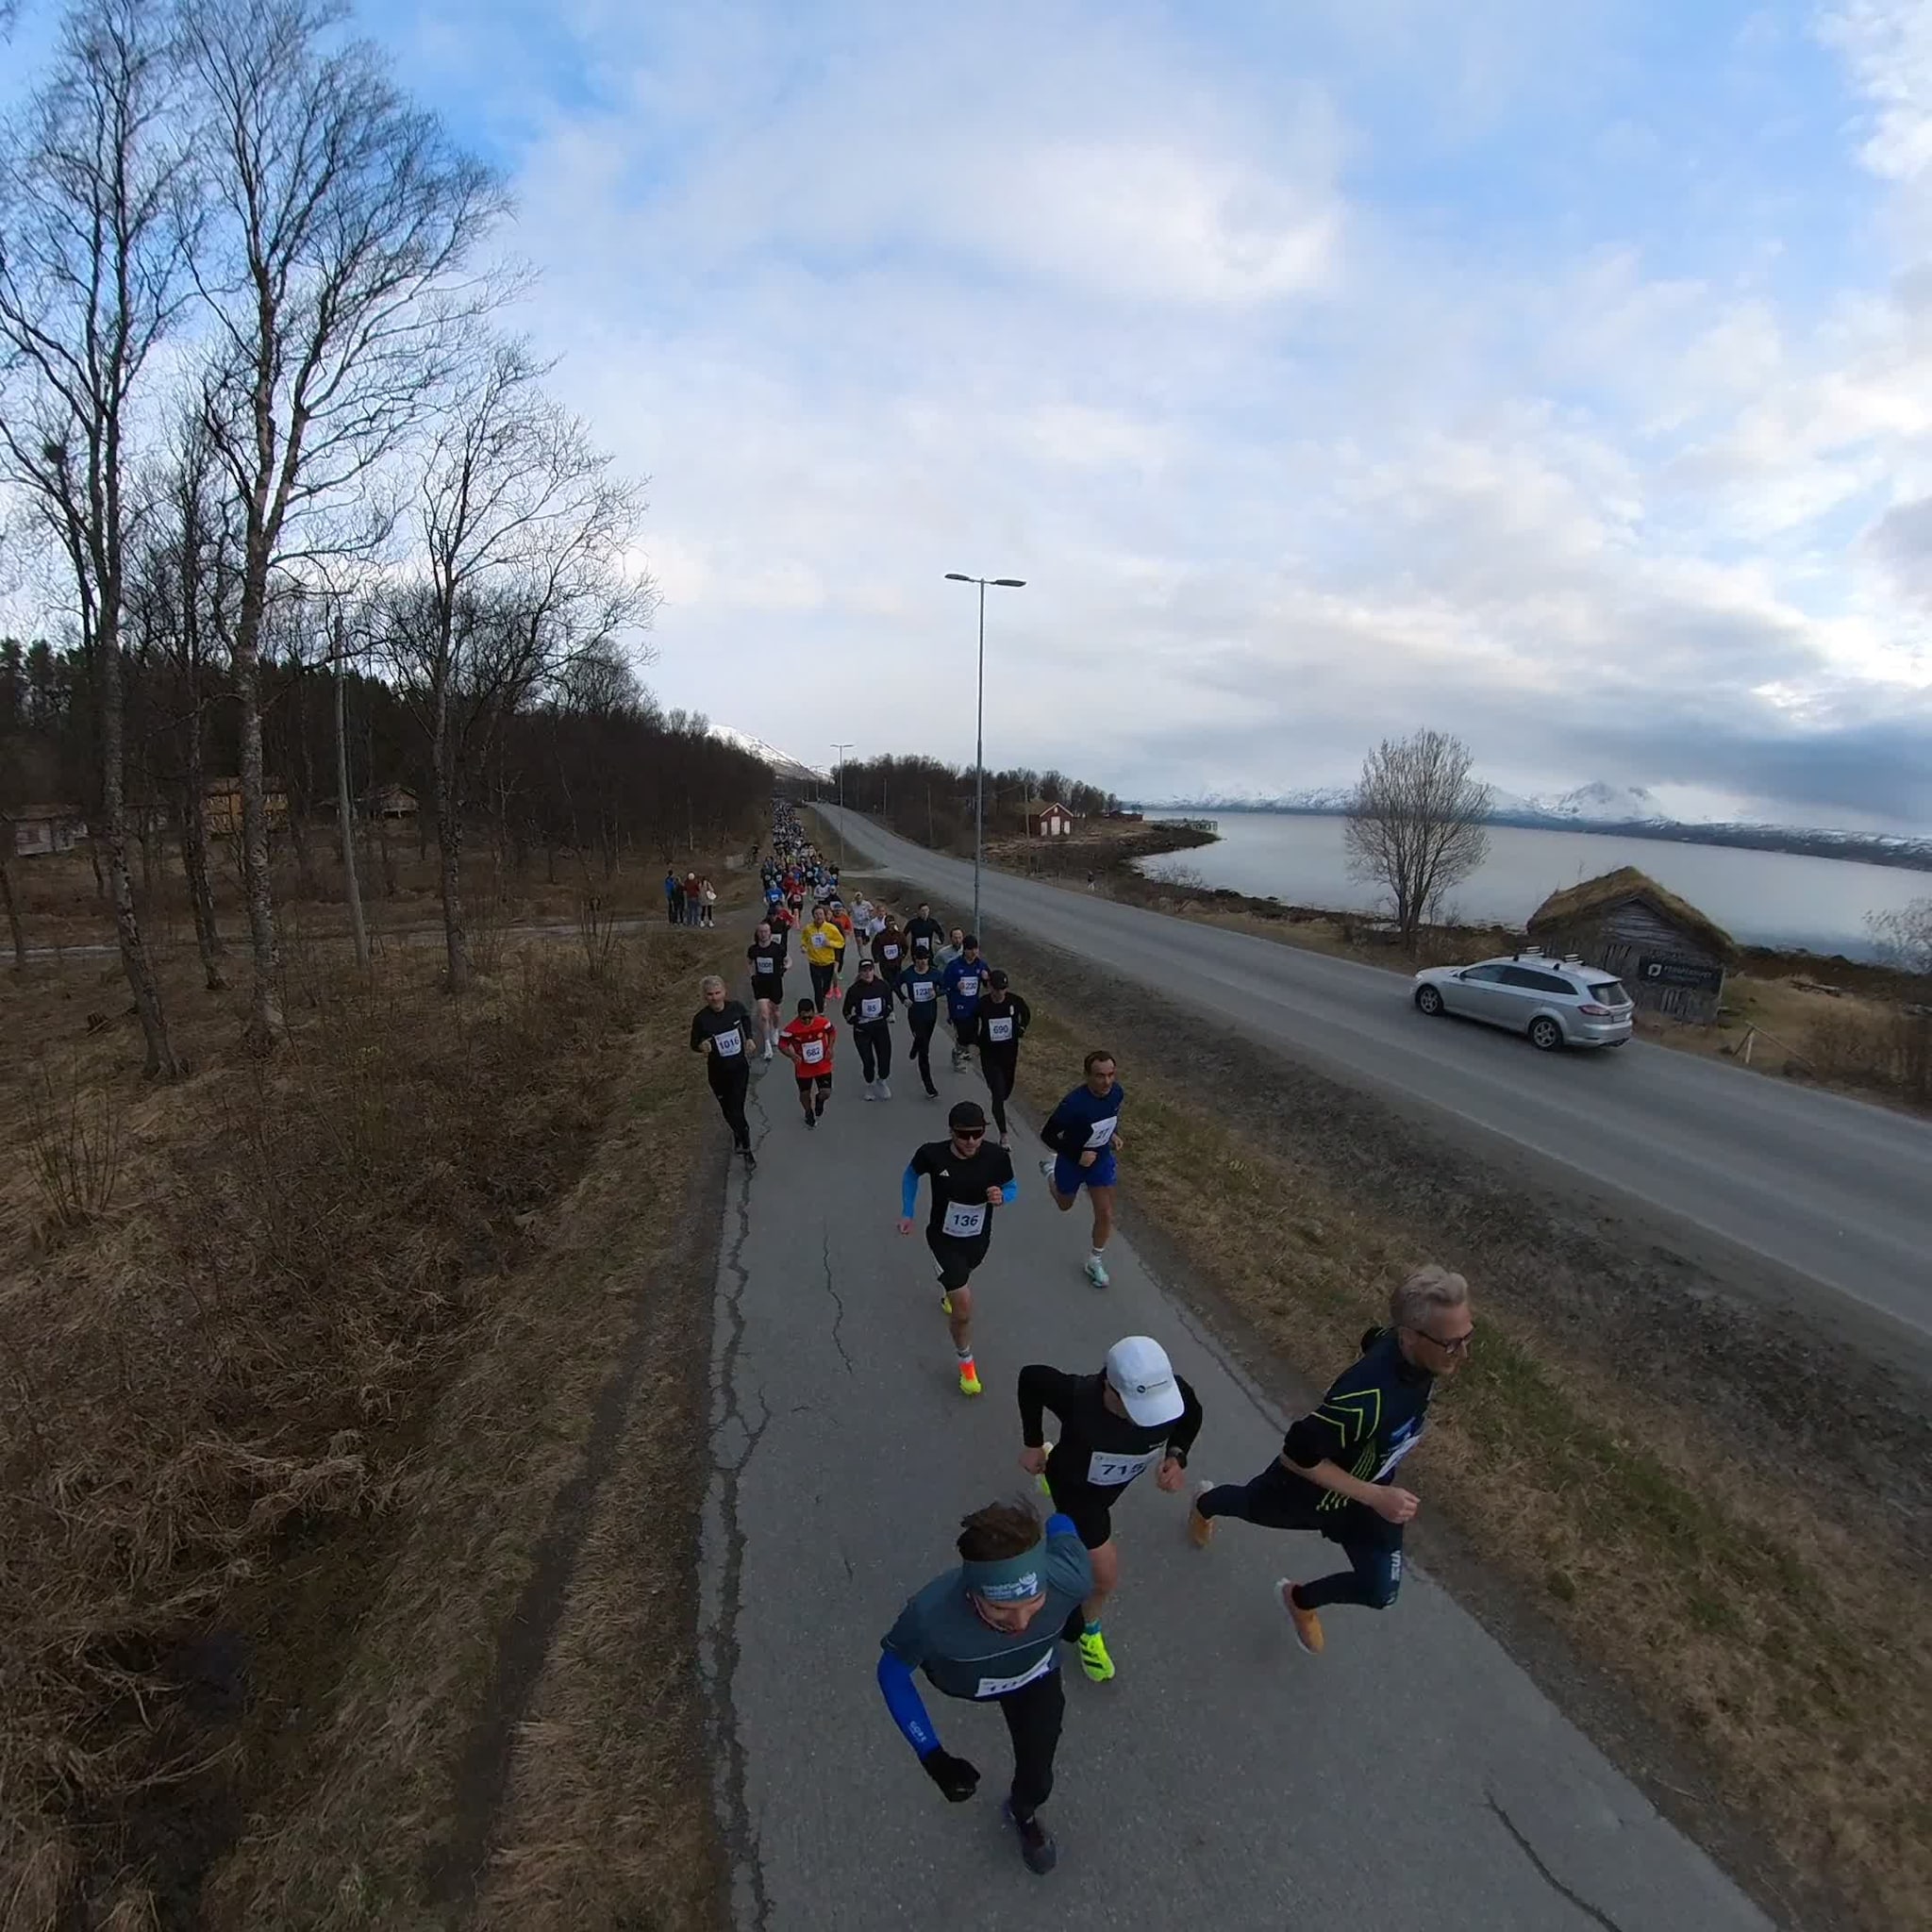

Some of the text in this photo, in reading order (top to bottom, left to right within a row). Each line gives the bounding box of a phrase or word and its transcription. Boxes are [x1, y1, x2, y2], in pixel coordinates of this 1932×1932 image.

[719, 1036, 740, 1050] 1016
[806, 1047, 820, 1057] 682
[954, 1214, 978, 1227] 136
